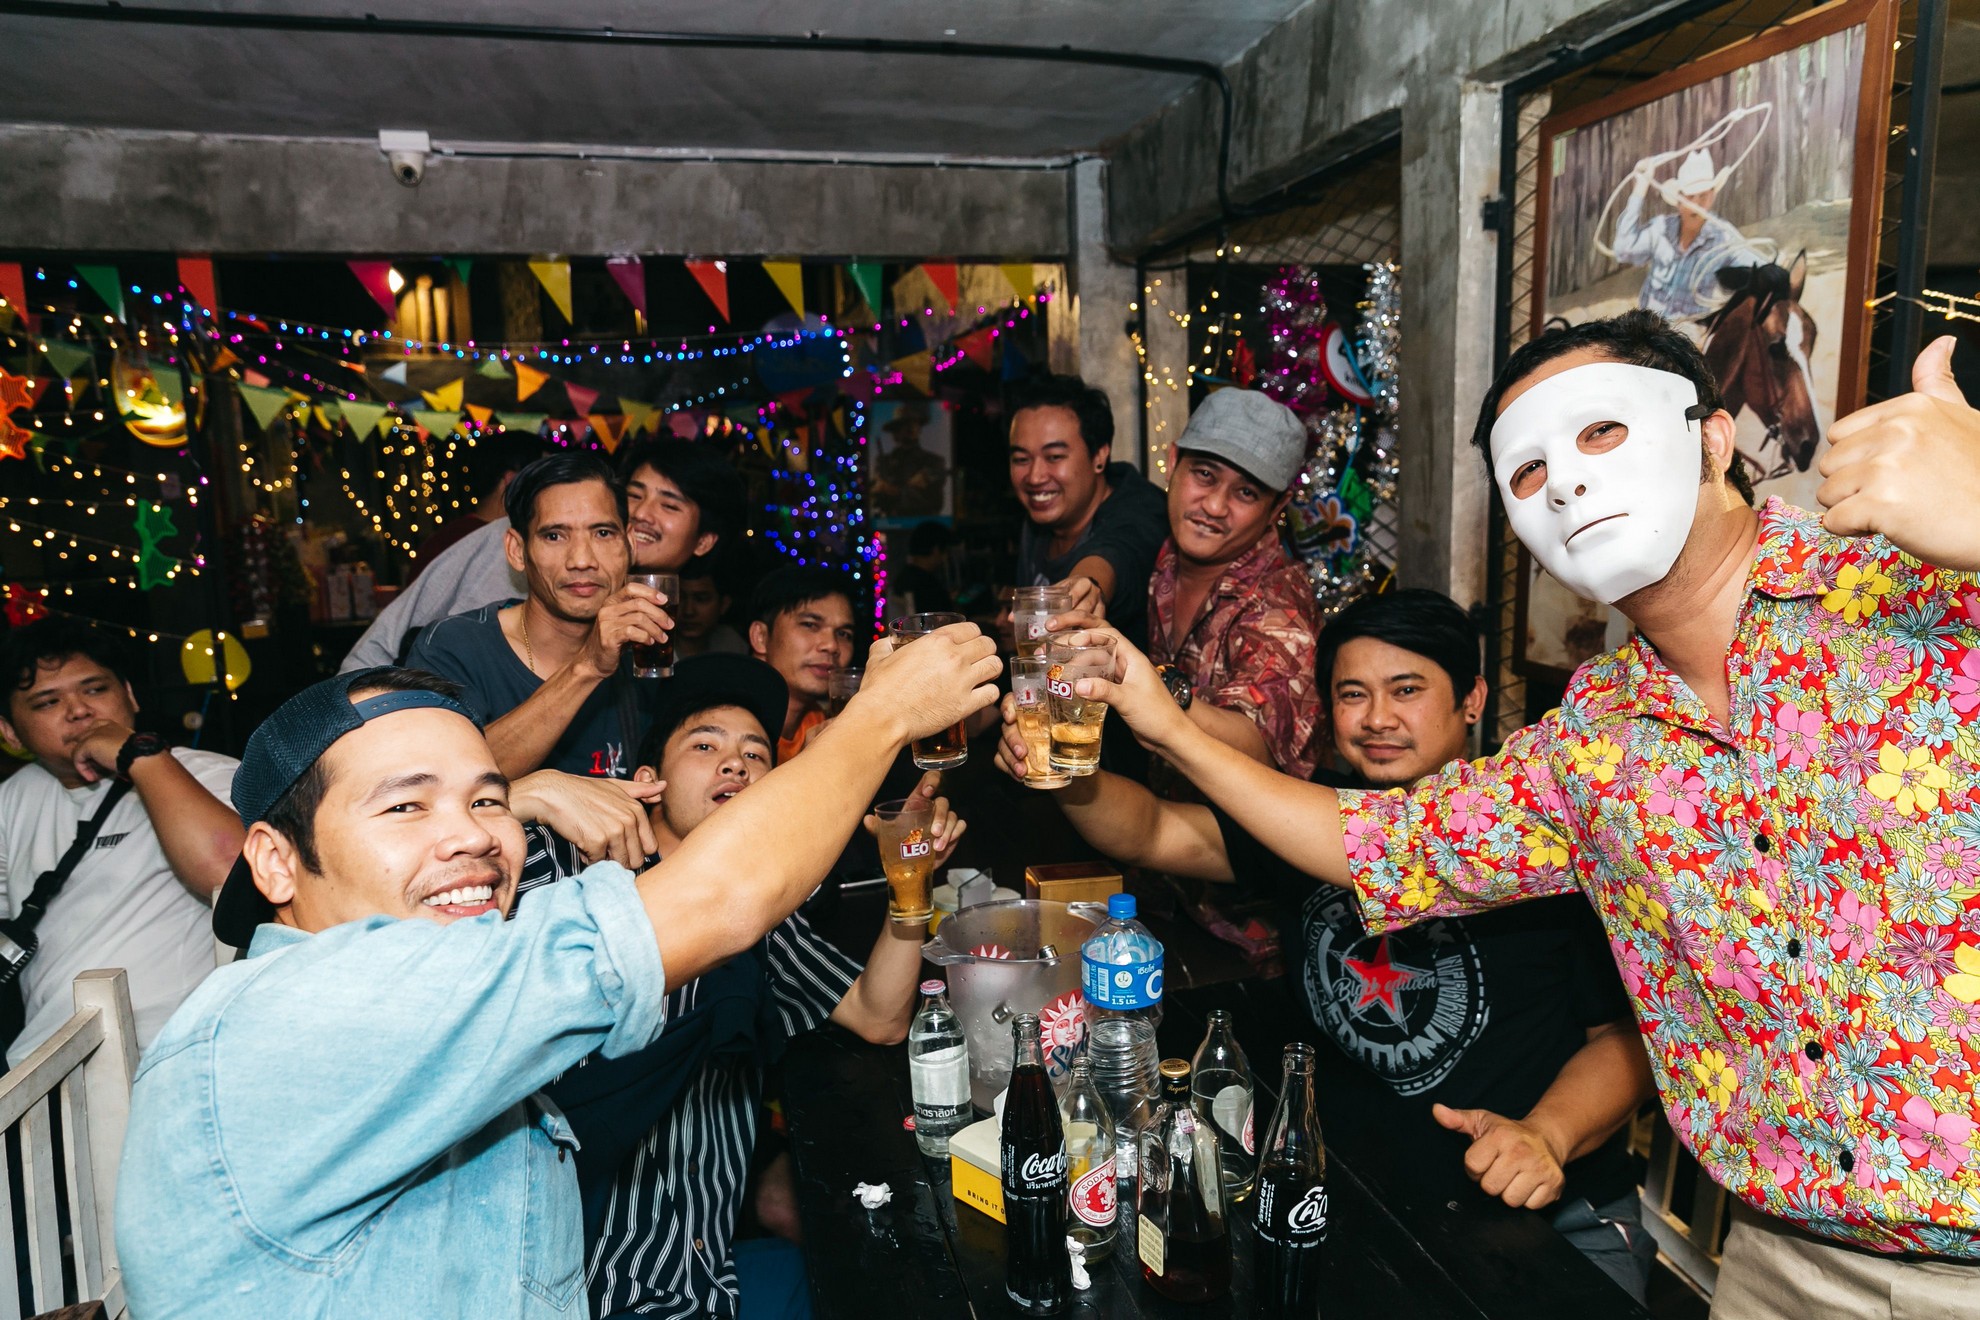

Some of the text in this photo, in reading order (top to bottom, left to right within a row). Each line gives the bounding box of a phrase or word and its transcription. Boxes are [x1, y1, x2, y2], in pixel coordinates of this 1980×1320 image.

[1046, 679, 1072, 698] LEO
[902, 842, 929, 858] LEO
[1331, 973, 1440, 1002] Black edition
[1166, 1084, 1189, 1095] Regency
[1081, 1172, 1105, 1191] SODA
[967, 1189, 989, 1206] BRING
[991, 1203, 998, 1211] IT
